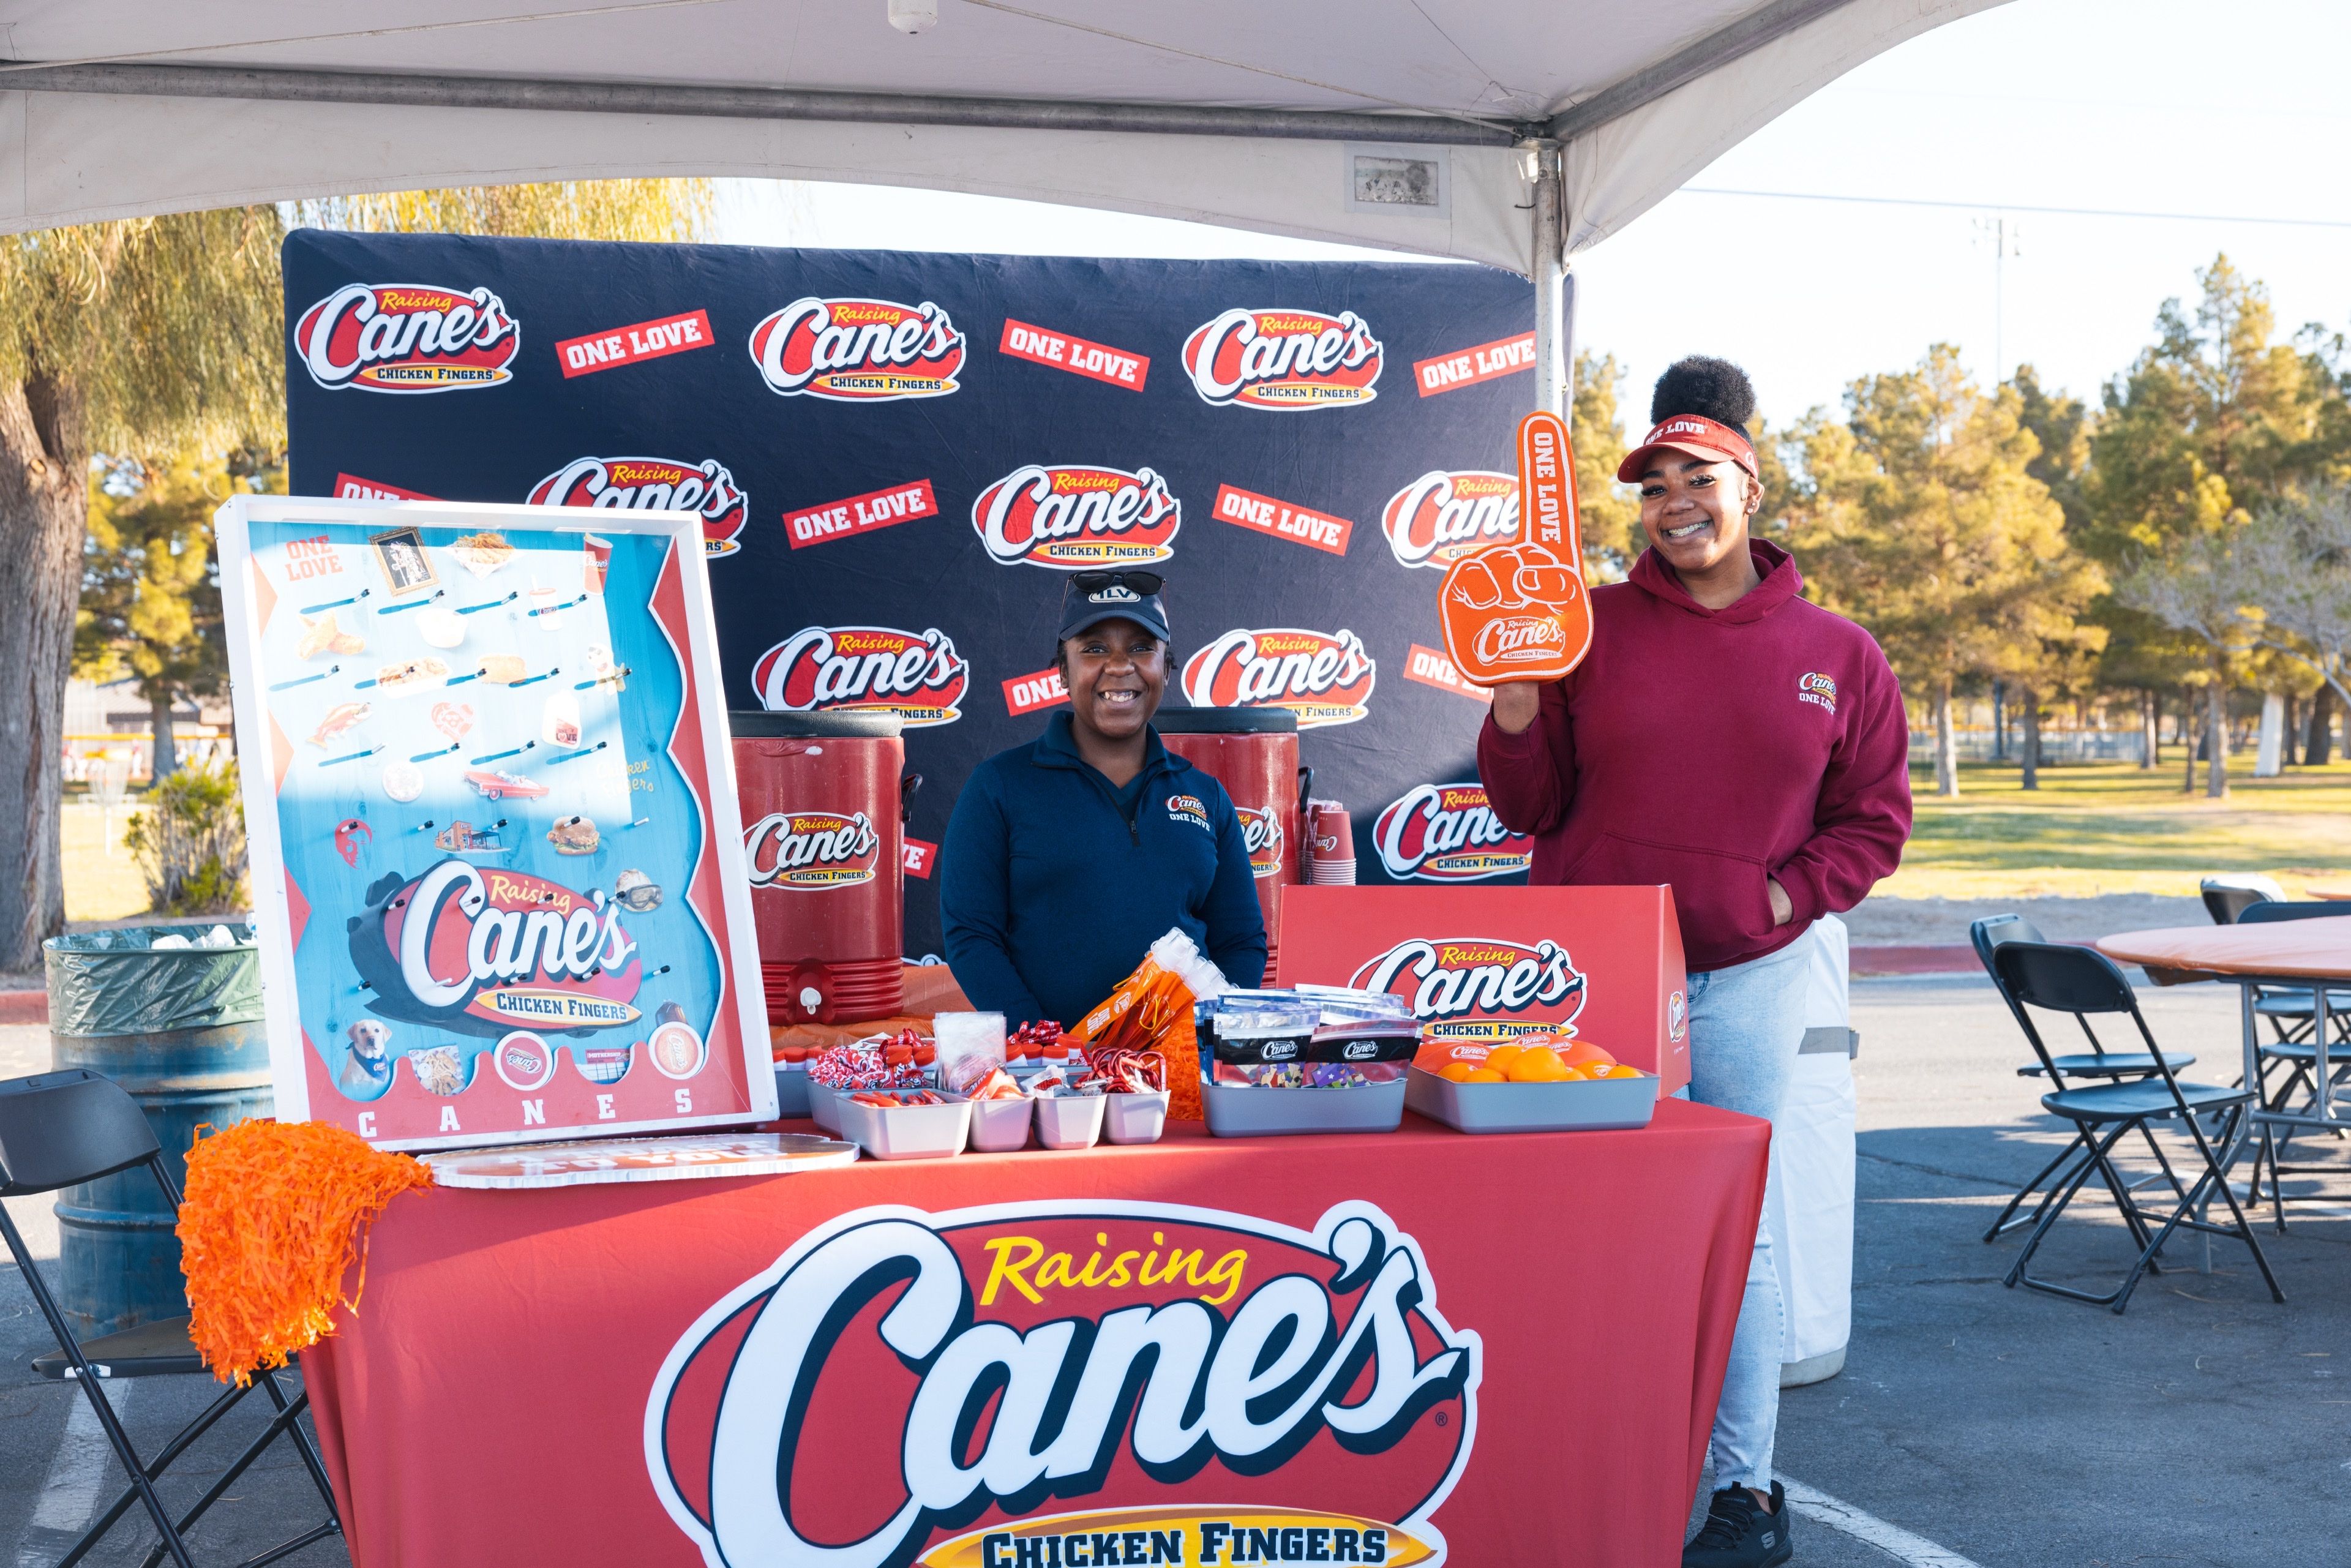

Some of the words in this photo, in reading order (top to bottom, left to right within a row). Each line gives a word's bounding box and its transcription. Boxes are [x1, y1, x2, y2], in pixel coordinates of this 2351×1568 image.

[380, 291, 452, 313] Raising
[834, 306, 901, 325] Raising
[1259, 315, 1324, 336] Raising
[308, 285, 515, 381] Cane's
[566, 336, 626, 369] ONE
[629, 318, 703, 355] LOVE
[763, 299, 961, 392] Cane's
[1009, 328, 1067, 364] ONE
[1070, 343, 1139, 383] LOVE
[1193, 309, 1378, 399] Cane's
[377, 367, 433, 380] CHICKEN
[437, 367, 493, 380] FINGERS
[1422, 356, 1473, 389] ONE
[1475, 337, 1535, 375] LOVE
[830, 375, 883, 389] CHICKEN
[888, 375, 942, 391] FINGERS
[1258, 386, 1308, 399] CHICKEN
[1311, 386, 1360, 399] FINGERS
[1665, 421, 1706, 434] LOVE
[1534, 432, 1556, 478] ONE
[612, 465, 682, 486] Raising
[1054, 473, 1120, 492] Raising
[1455, 478, 1512, 498] Raising
[793, 507, 853, 541] ONE
[855, 489, 927, 527] LOVE
[984, 467, 1176, 558] Cane's
[1221, 492, 1272, 527] ONE
[1280, 508, 1344, 547] LOVE
[1537, 484, 1561, 542] LOVE
[285, 535, 333, 559] ONE
[1049, 544, 1102, 557] CHICKEN
[1105, 544, 1157, 558] FINGERS
[285, 555, 343, 581] LOVE
[1507, 619, 1539, 629] Raising
[837, 634, 906, 654] Raising
[1259, 637, 1321, 655] Raising
[1477, 617, 1562, 662] Cane's
[765, 629, 962, 711] Cane's
[1193, 631, 1371, 707] Cane's
[1412, 652, 1458, 686] ONE
[1012, 673, 1069, 707] ONE
[1306, 707, 1352, 716] FINGERS
[1799, 692, 1820, 704] ONE
[1820, 697, 1836, 715] LOVE
[1442, 790, 1493, 808] Raisin
[793, 817, 842, 832] Raising
[1169, 813, 1190, 822] ONE
[1190, 814, 1210, 831] LOVE
[745, 814, 878, 882] Cane's
[1437, 858, 1480, 869] CHICKEN
[1483, 857, 1524, 867] FINGERS
[790, 871, 829, 881] CHICKEN
[831, 871, 866, 880] FINGERS
[490, 874, 571, 915] Raising
[400, 860, 638, 1007] Cane's
[1440, 946, 1517, 967] Raising
[1366, 941, 1582, 1017] Cane's
[496, 992, 563, 1015] CHICKEN
[568, 999, 628, 1021] FINGERS
[1433, 1023, 1496, 1036] CHICKEN
[1262, 1040, 1296, 1059] Cane's
[1344, 1041, 1377, 1058] Cane's
[1452, 1046, 1487, 1057] Cane's
[980, 1231, 1248, 1305] Raising
[708, 1217, 1463, 1568] Cane's
[982, 1529, 1182, 1568] CHICKEN
[1201, 1521, 1387, 1567] FINGERS
